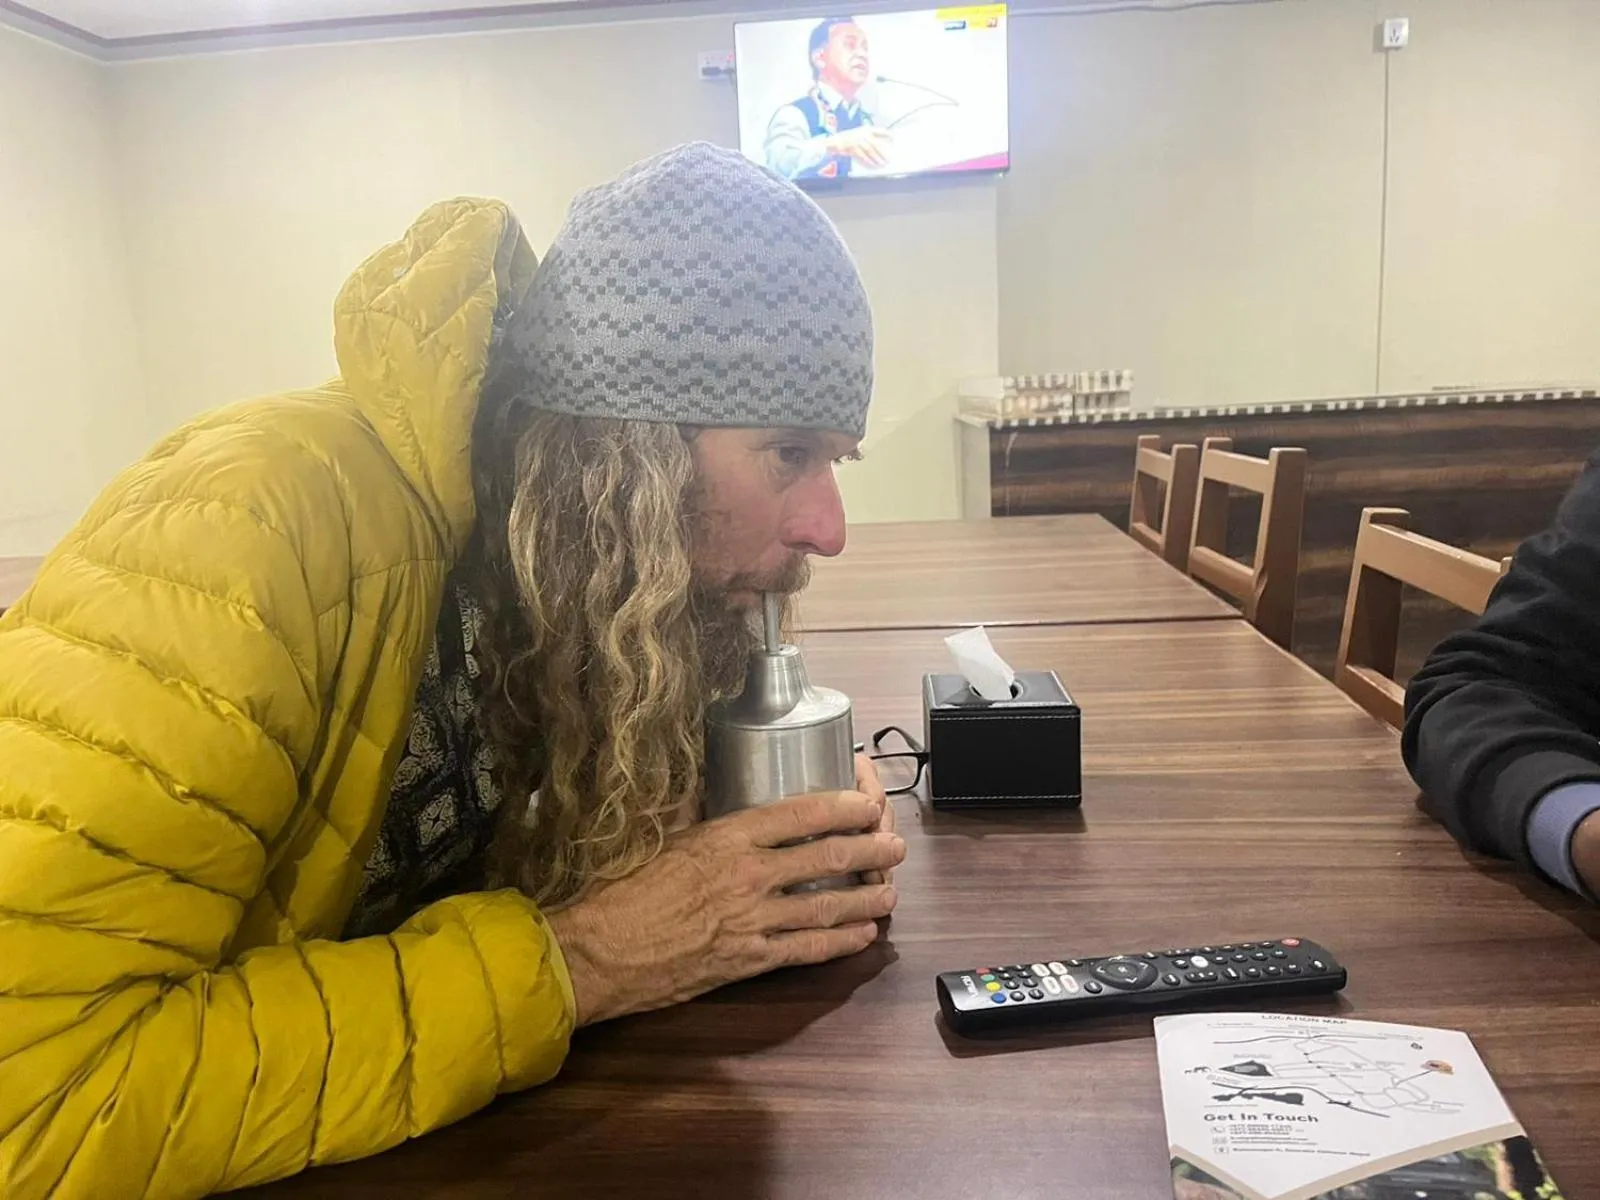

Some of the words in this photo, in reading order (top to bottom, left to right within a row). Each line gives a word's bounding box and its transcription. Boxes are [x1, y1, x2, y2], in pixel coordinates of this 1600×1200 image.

[1261, 1015, 1320, 1023] LOCATION
[1203, 1113, 1235, 1122] Get
[1241, 1113, 1258, 1121] In
[1263, 1113, 1319, 1123] Touch
